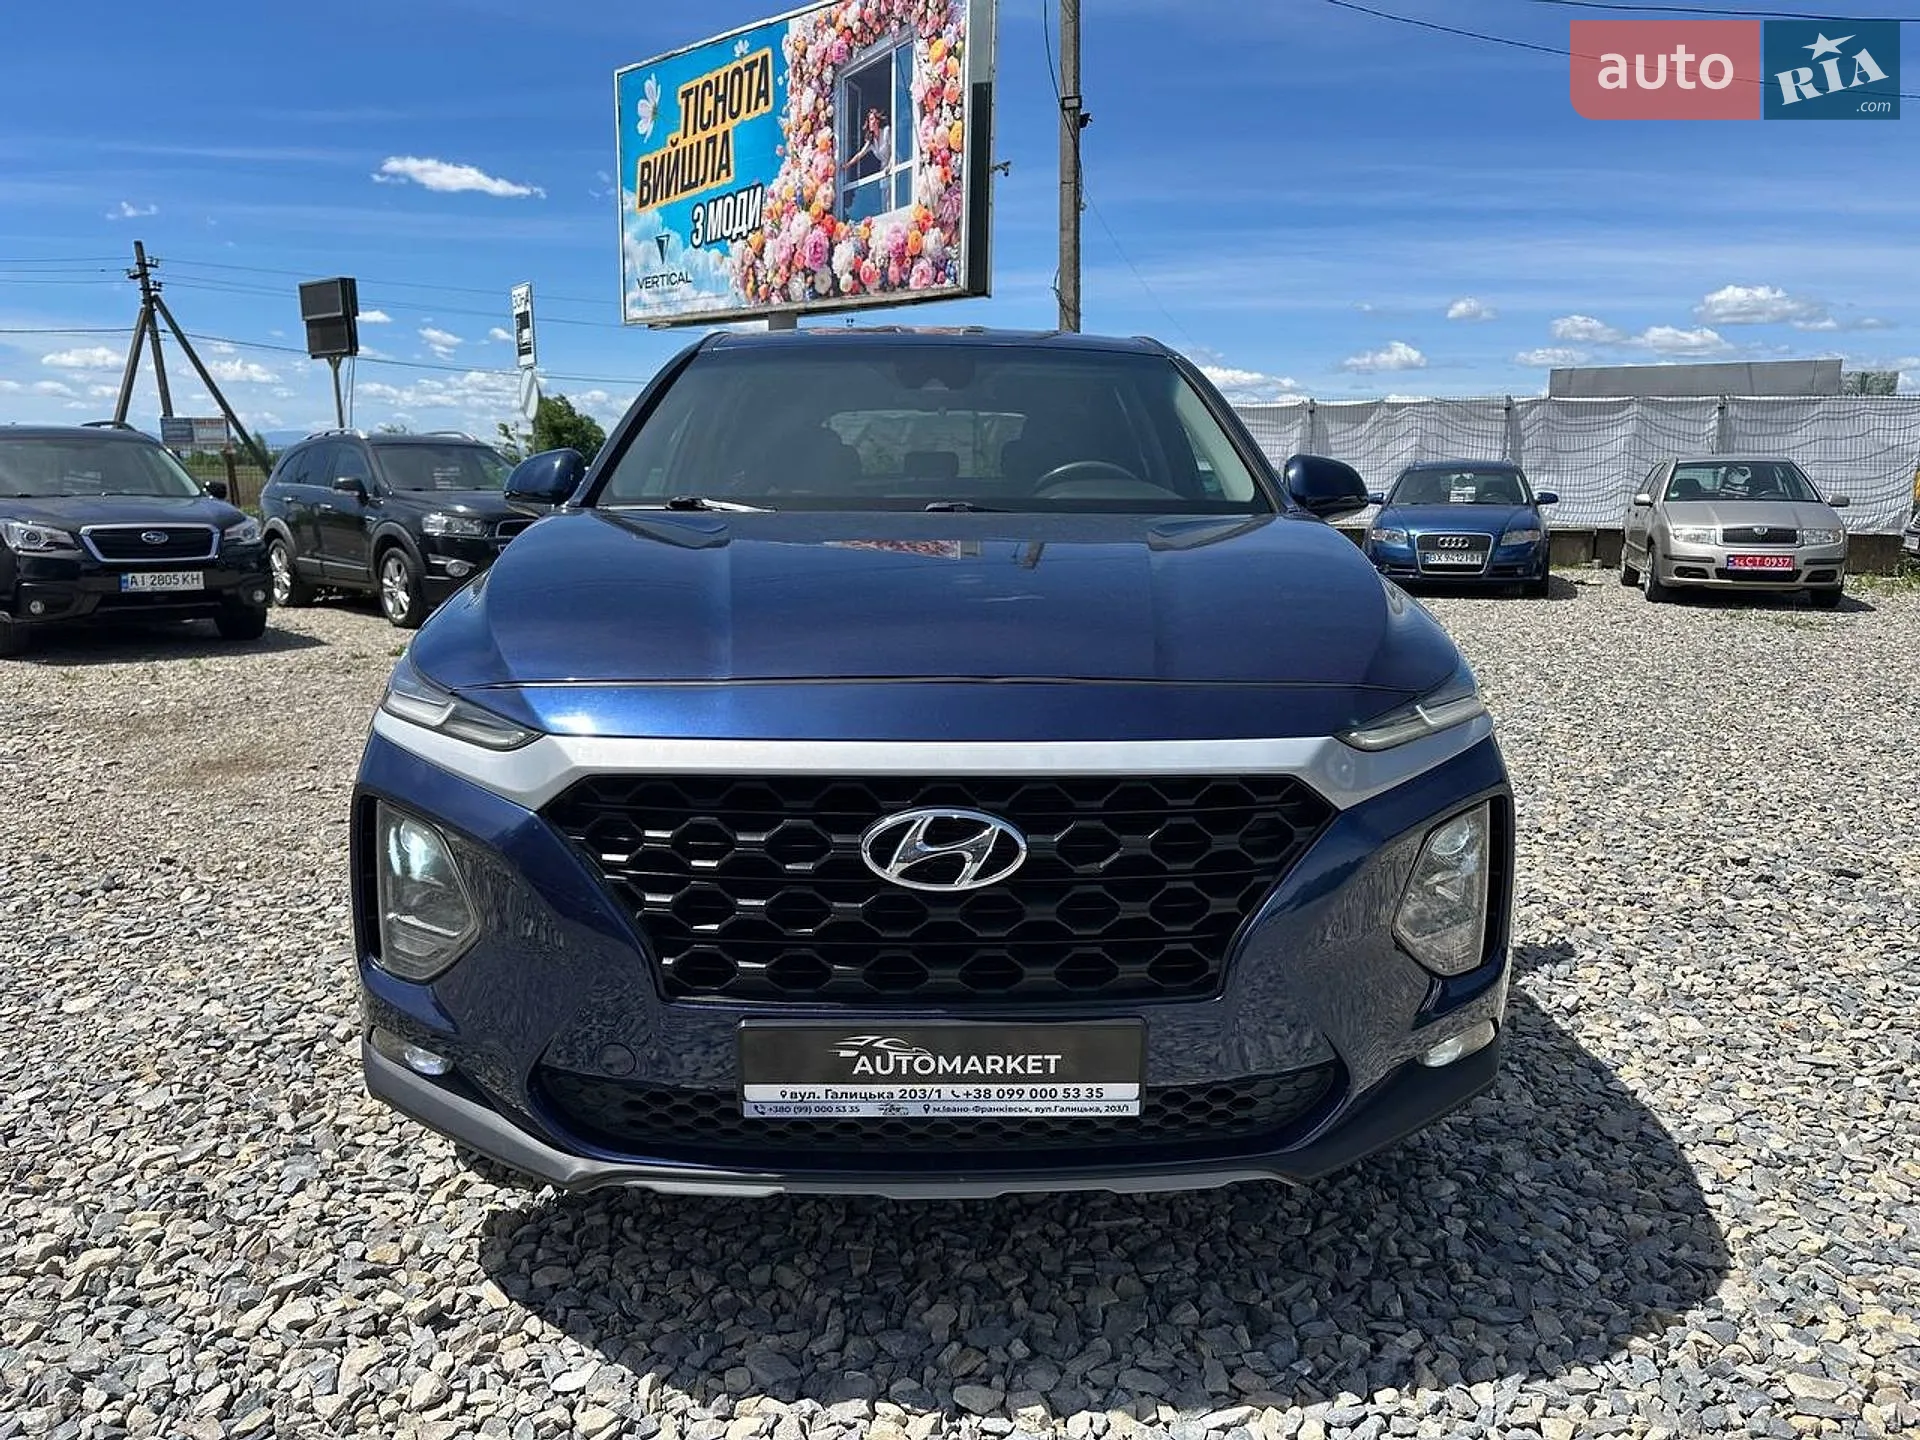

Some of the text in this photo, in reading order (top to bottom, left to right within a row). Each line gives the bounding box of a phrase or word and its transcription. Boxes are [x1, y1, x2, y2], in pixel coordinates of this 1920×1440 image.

[681, 53, 770, 140] ТІСНОТА
[638, 129, 732, 209] ВИЙШЛА
[691, 186, 763, 247] З МОДИ
[637, 271, 692, 289] VERTICAL
[1764, 557, 1790, 567] 0937
[150, 574, 180, 587] 2805
[181, 572, 200, 585] KH
[852, 1054, 1062, 1075] AUTOMARKET
[790, 1086, 1104, 1101] вул. Галицька 203/1 +38 099 000 53 35
